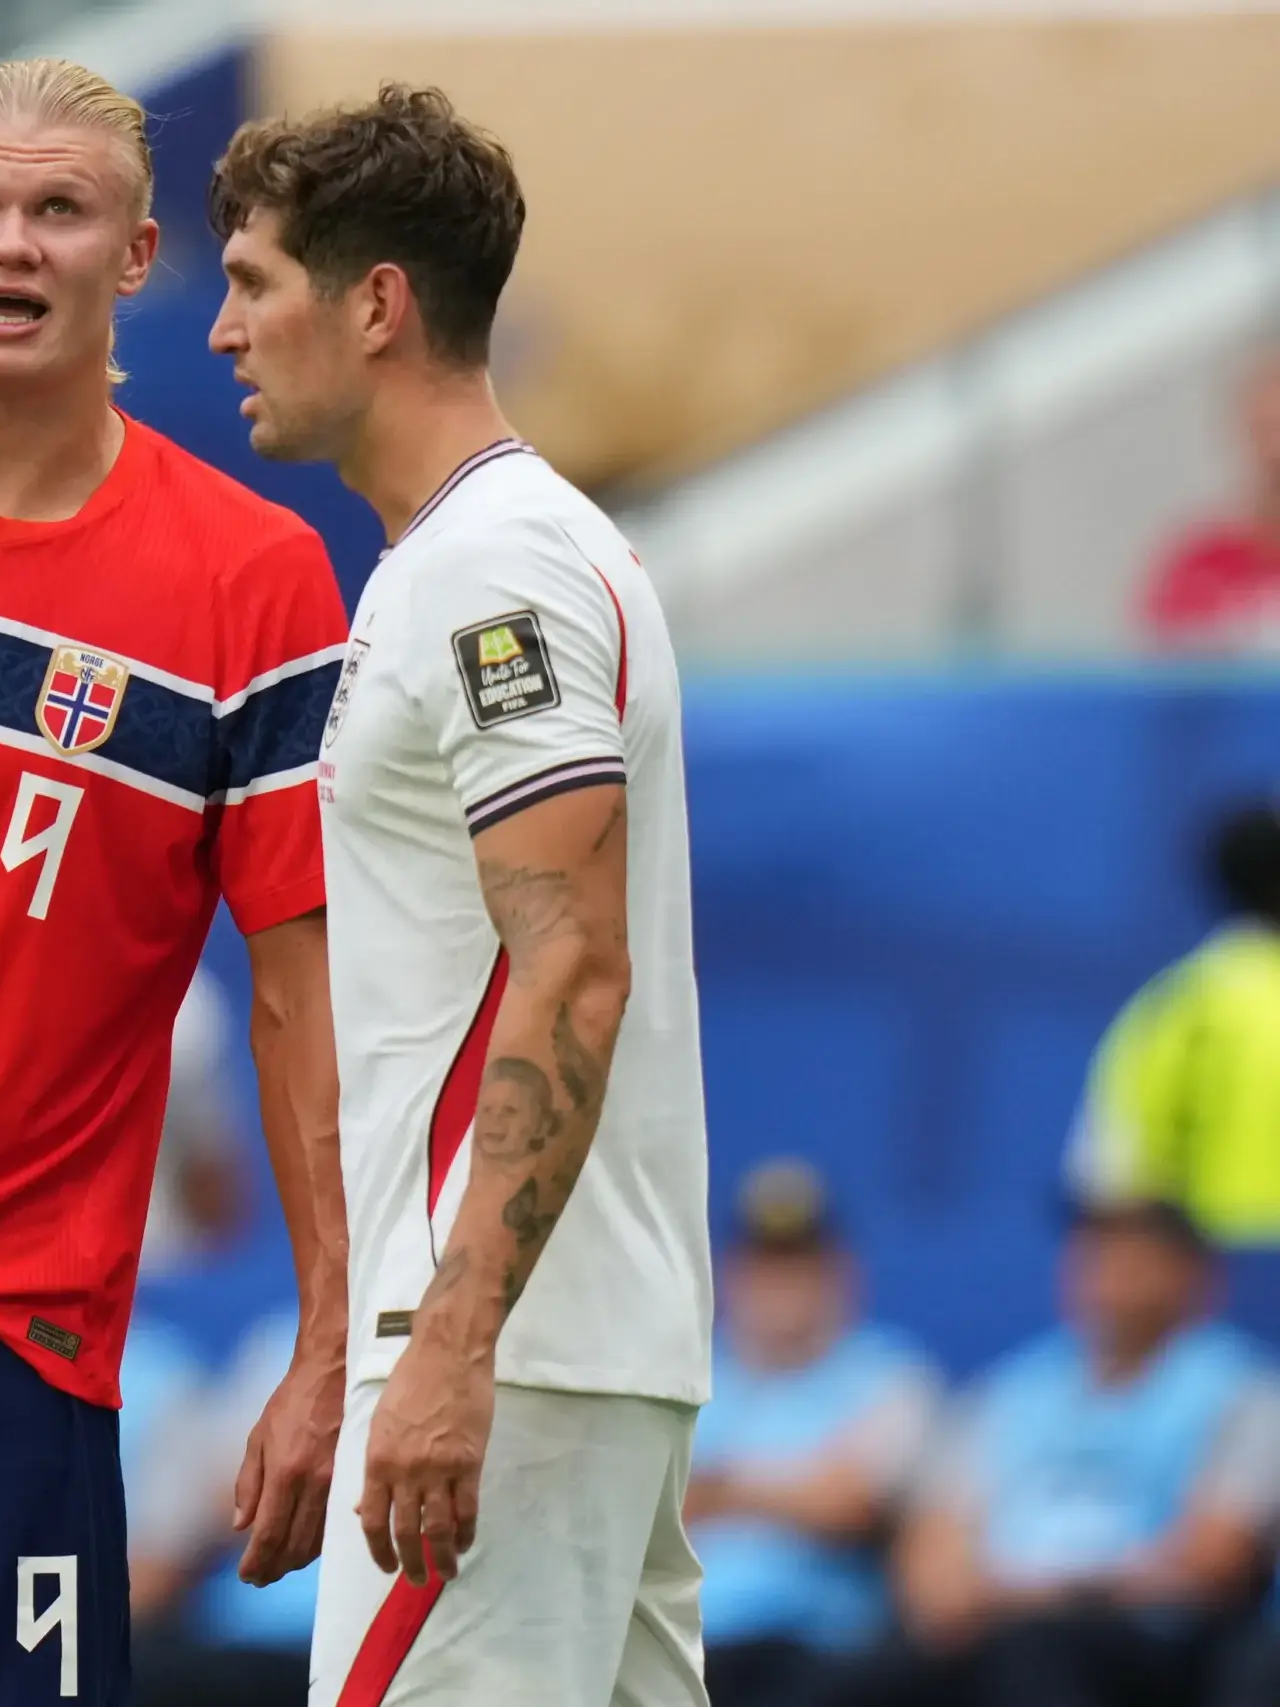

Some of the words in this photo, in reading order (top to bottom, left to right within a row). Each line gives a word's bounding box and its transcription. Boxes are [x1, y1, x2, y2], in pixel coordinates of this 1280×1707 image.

[80, 653, 104, 668] NORGE
[478, 673, 544, 708] EDUCATION
[502, 697, 528, 712] FIFA
[0, 771, 85, 920] 9
[16, 1555, 78, 1697] 9
